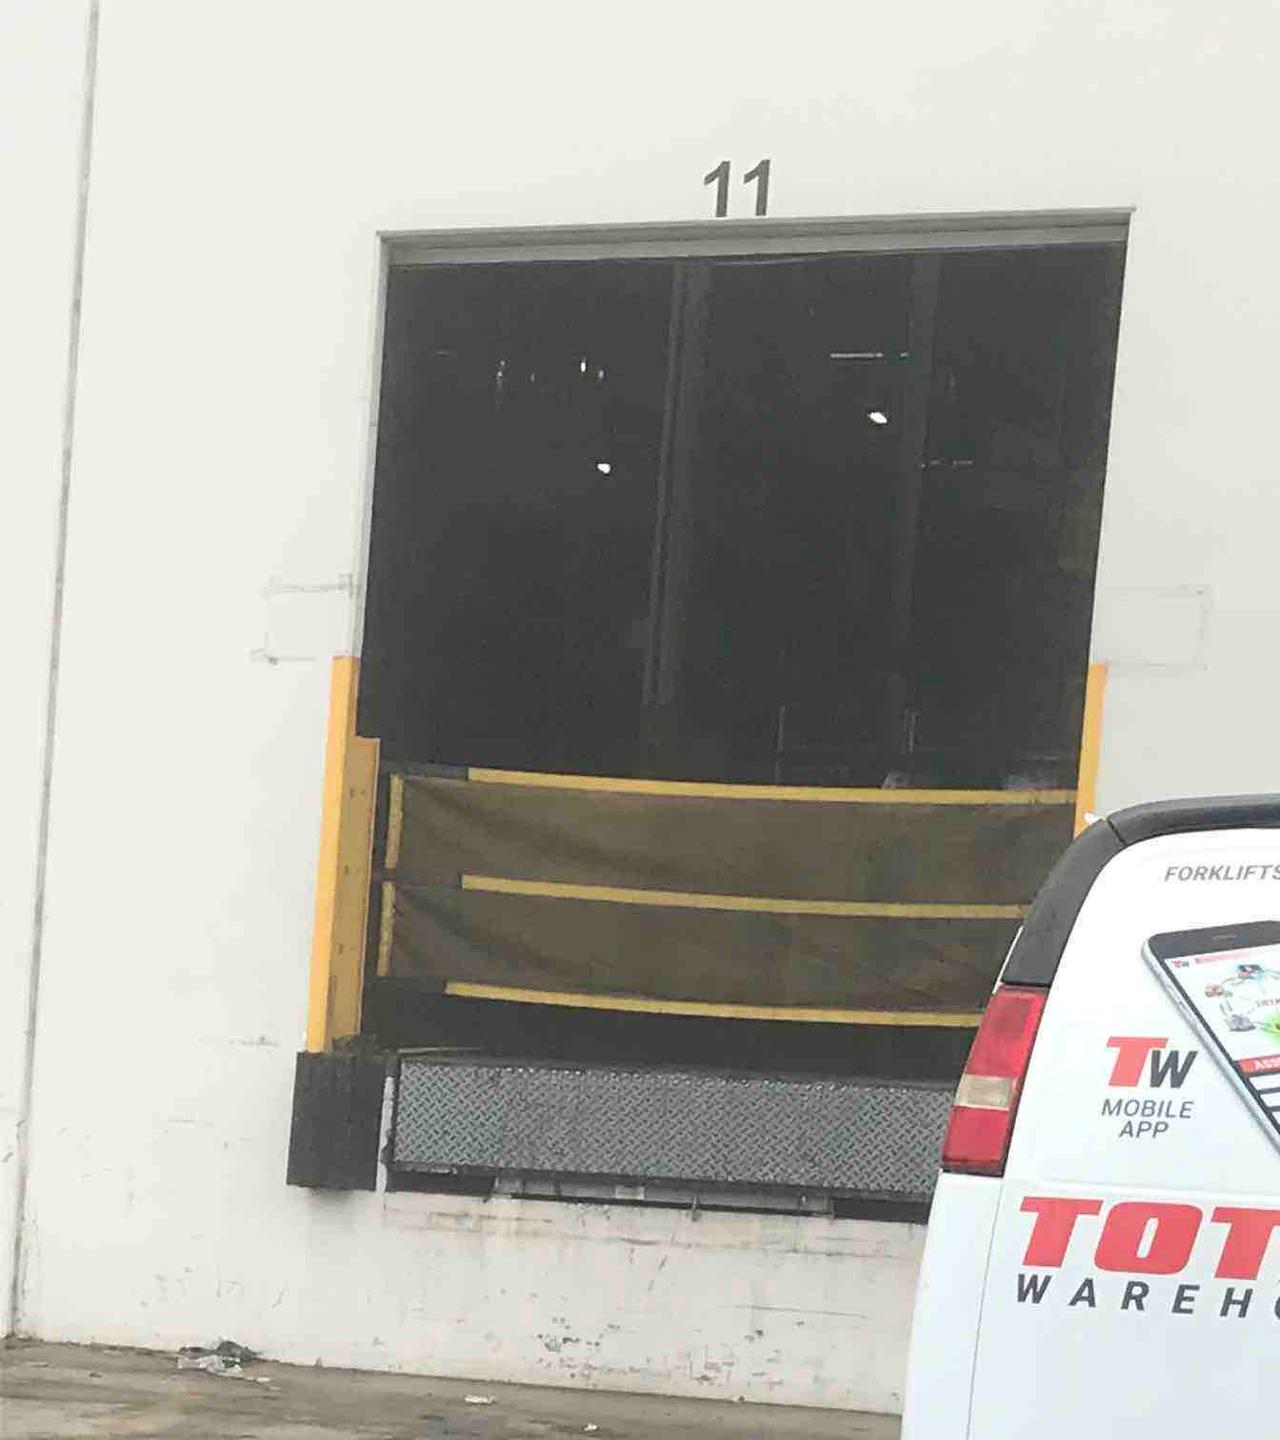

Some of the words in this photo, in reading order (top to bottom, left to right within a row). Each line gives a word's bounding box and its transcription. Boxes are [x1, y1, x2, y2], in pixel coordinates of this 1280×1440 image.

[704, 159, 771, 218] 11
[1164, 864, 1280, 882] FORKLIFTS
[1106, 1036, 1199, 1089] TW
[1100, 1098, 1195, 1120] MOBILE
[1118, 1120, 1170, 1140] APP
[1019, 1196, 1280, 1281] TOT
[1016, 1273, 1280, 1320] WAREH
